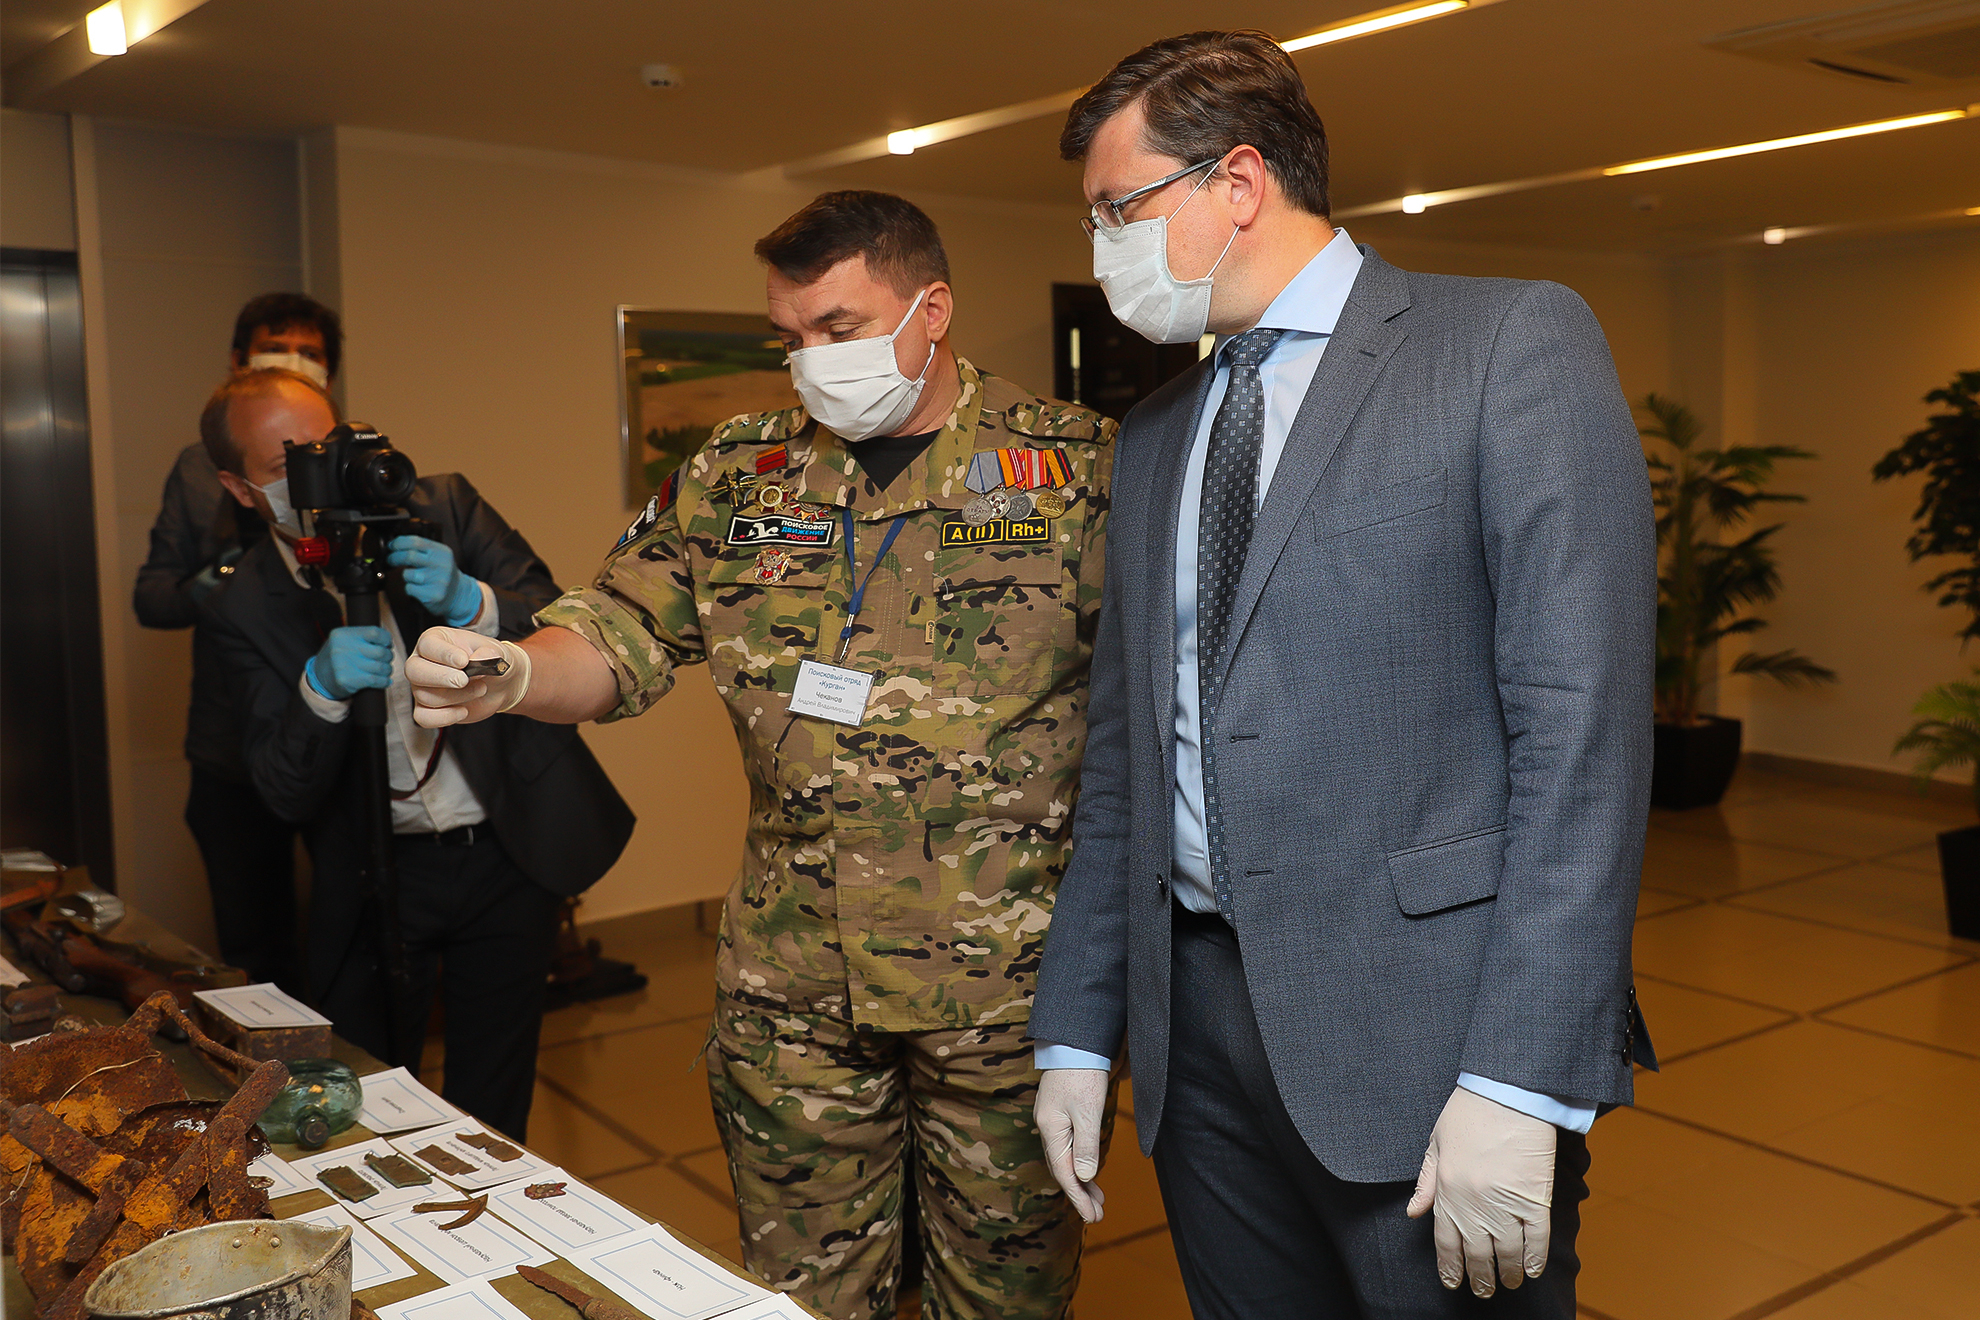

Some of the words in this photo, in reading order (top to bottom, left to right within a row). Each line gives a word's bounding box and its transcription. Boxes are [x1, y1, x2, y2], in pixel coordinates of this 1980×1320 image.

[781, 520, 828, 531] ПОИСКОВОЕ
[781, 526, 825, 536] ДВИЖЕНИЕ
[1012, 523, 1044, 537] Rh+
[786, 533, 818, 541] РОССИИ
[808, 667, 843, 682] Поисковый
[843, 676, 862, 686] отряд
[815, 691, 843, 703] Чеканов
[797, 697, 816, 706] Андрей
[816, 702, 856, 715] Владимирович
